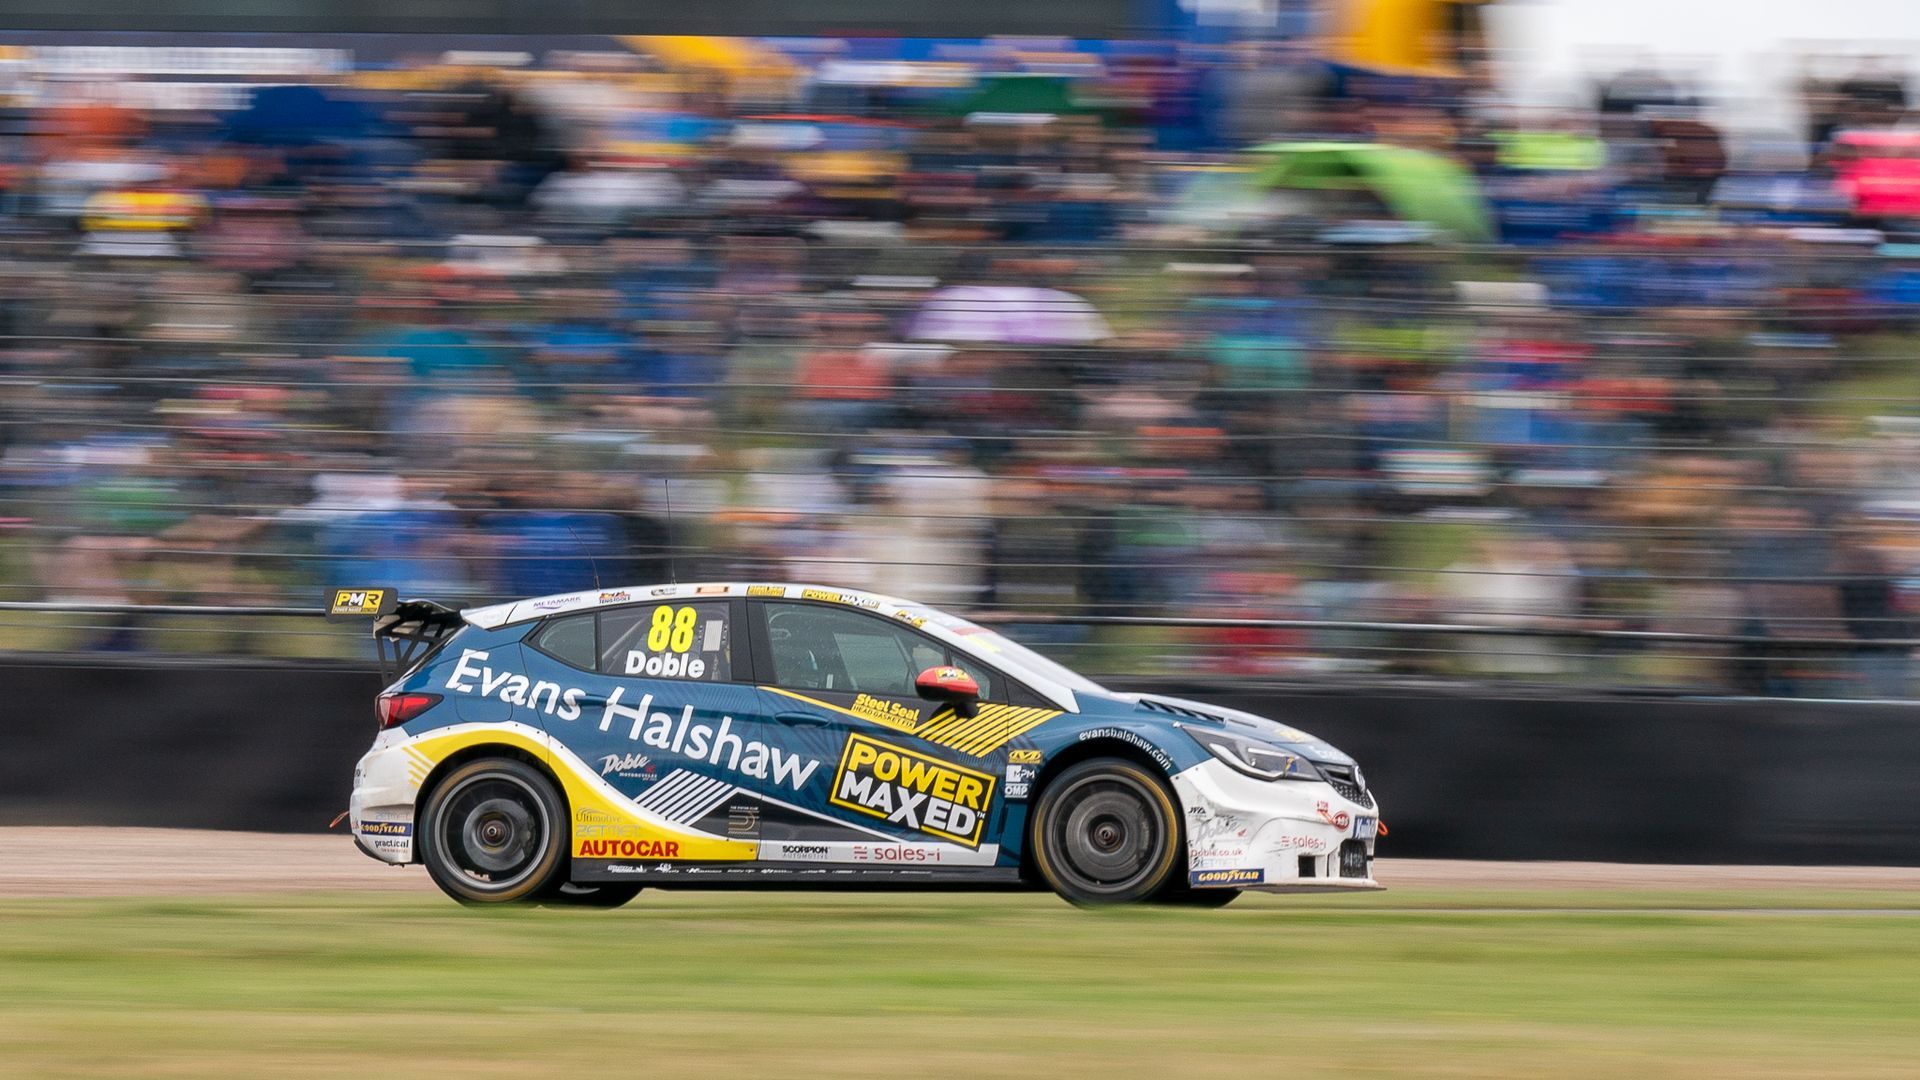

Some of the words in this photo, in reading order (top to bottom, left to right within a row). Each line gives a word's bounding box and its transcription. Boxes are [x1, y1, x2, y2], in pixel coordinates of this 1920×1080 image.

[336, 592, 380, 606] PMR
[804, 589, 841, 602] POWER
[647, 605, 697, 653] 88
[625, 650, 705, 678] Doble
[855, 693, 891, 713] Steel
[889, 702, 920, 721] Seal
[446, 648, 586, 721] Evans
[600, 686, 820, 791] Halshaw
[1079, 727, 1172, 770] evanshalshaw.com
[598, 753, 651, 777] Doble
[848, 742, 983, 809] POWER
[1004, 785, 1028, 796] OMP
[839, 770, 976, 836] MAXED
[361, 822, 406, 834] GOODYEAR
[375, 839, 409, 848] practical
[579, 840, 679, 857] AUTOCAR
[782, 845, 829, 854] SCORPION
[874, 844, 941, 862] sales-i
[1198, 870, 1259, 882] GOODYEAR
